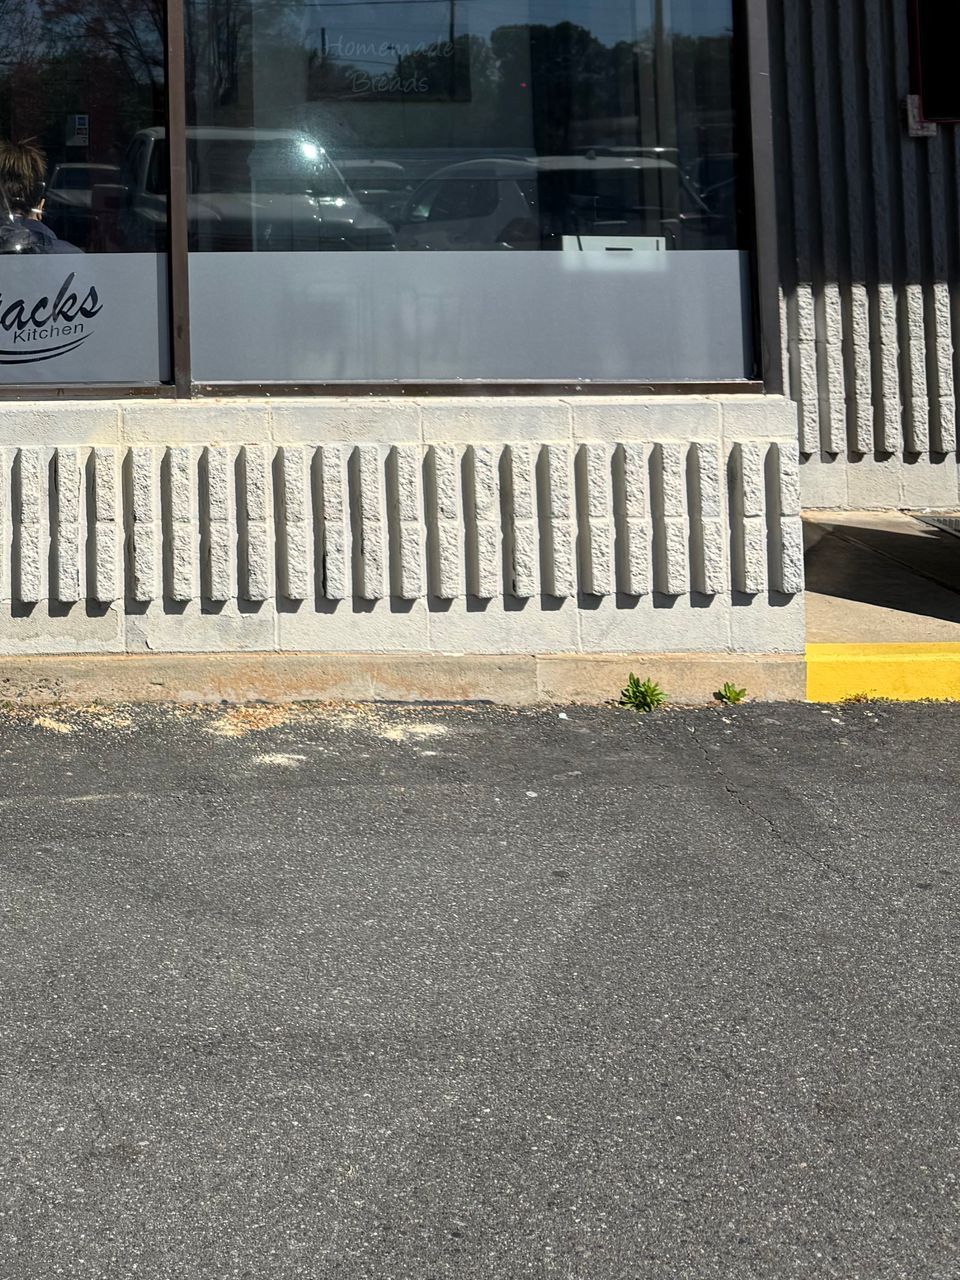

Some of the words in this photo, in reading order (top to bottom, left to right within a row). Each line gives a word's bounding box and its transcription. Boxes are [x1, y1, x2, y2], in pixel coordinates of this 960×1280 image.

[324, 35, 457, 57] Homemade
[347, 71, 429, 93] Breads
[12, 322, 85, 345] Kitchen
